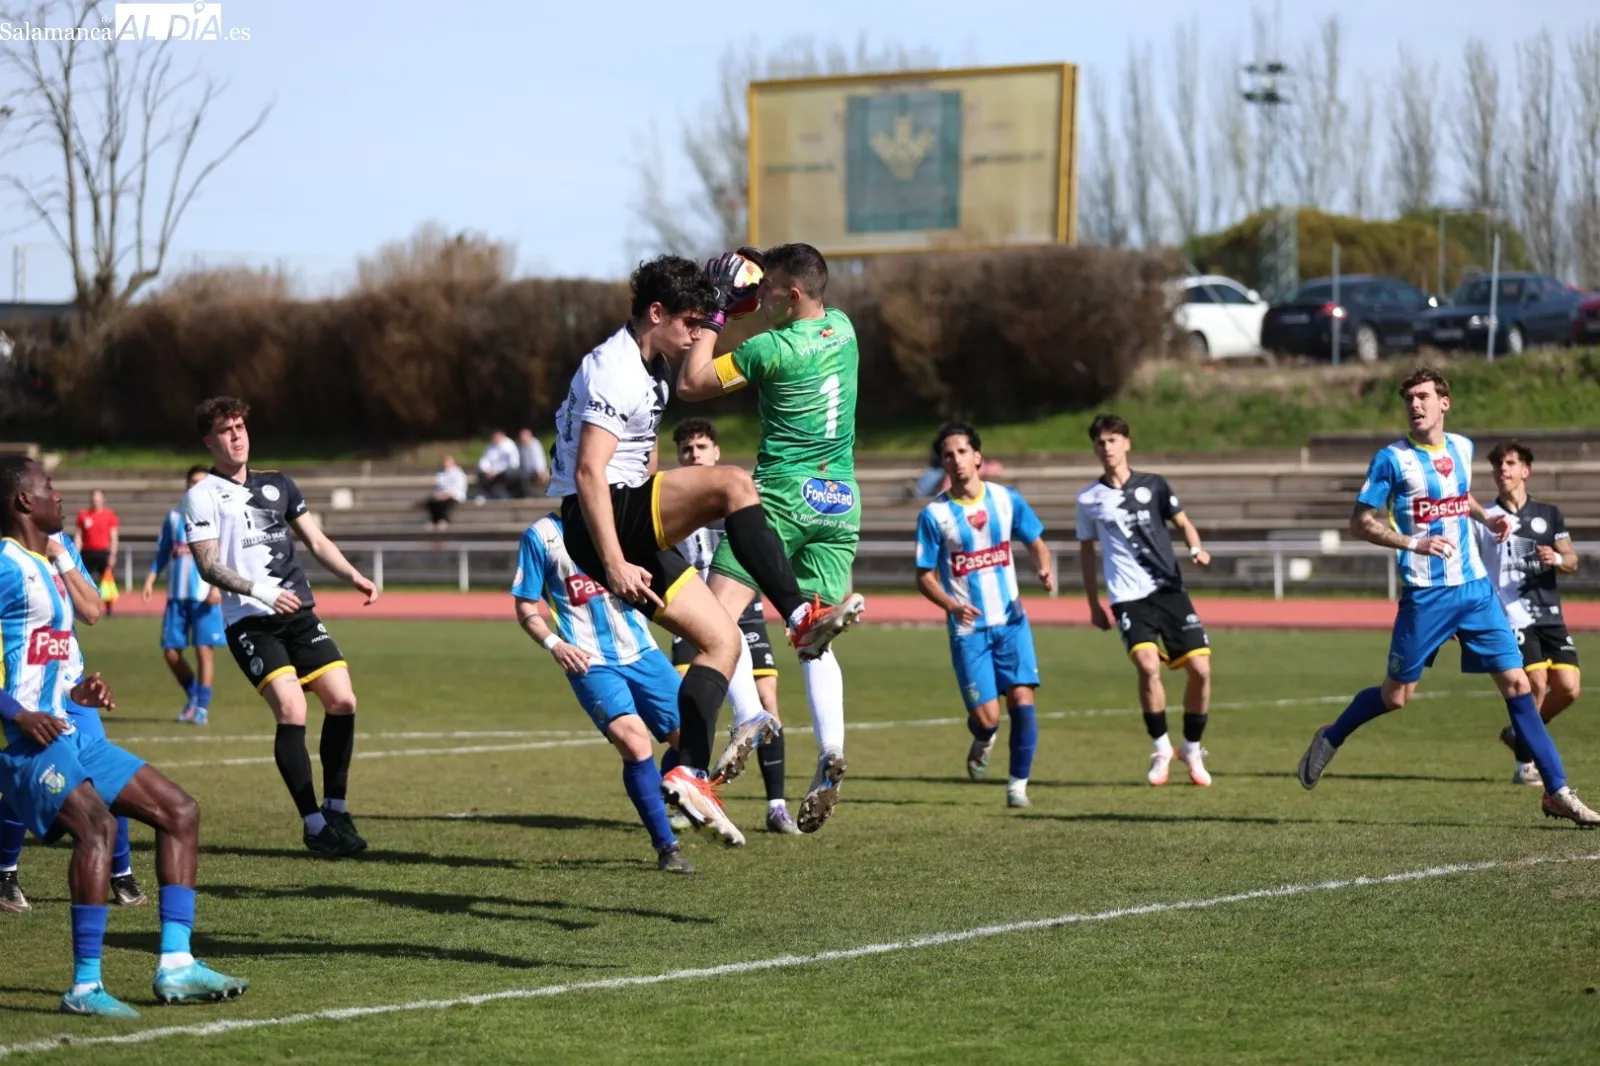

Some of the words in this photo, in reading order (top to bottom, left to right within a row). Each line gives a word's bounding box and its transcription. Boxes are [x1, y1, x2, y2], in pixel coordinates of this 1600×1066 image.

[819, 373, 840, 439] 1
[1122, 611, 1131, 631] 6
[238, 631, 255, 656] 5
